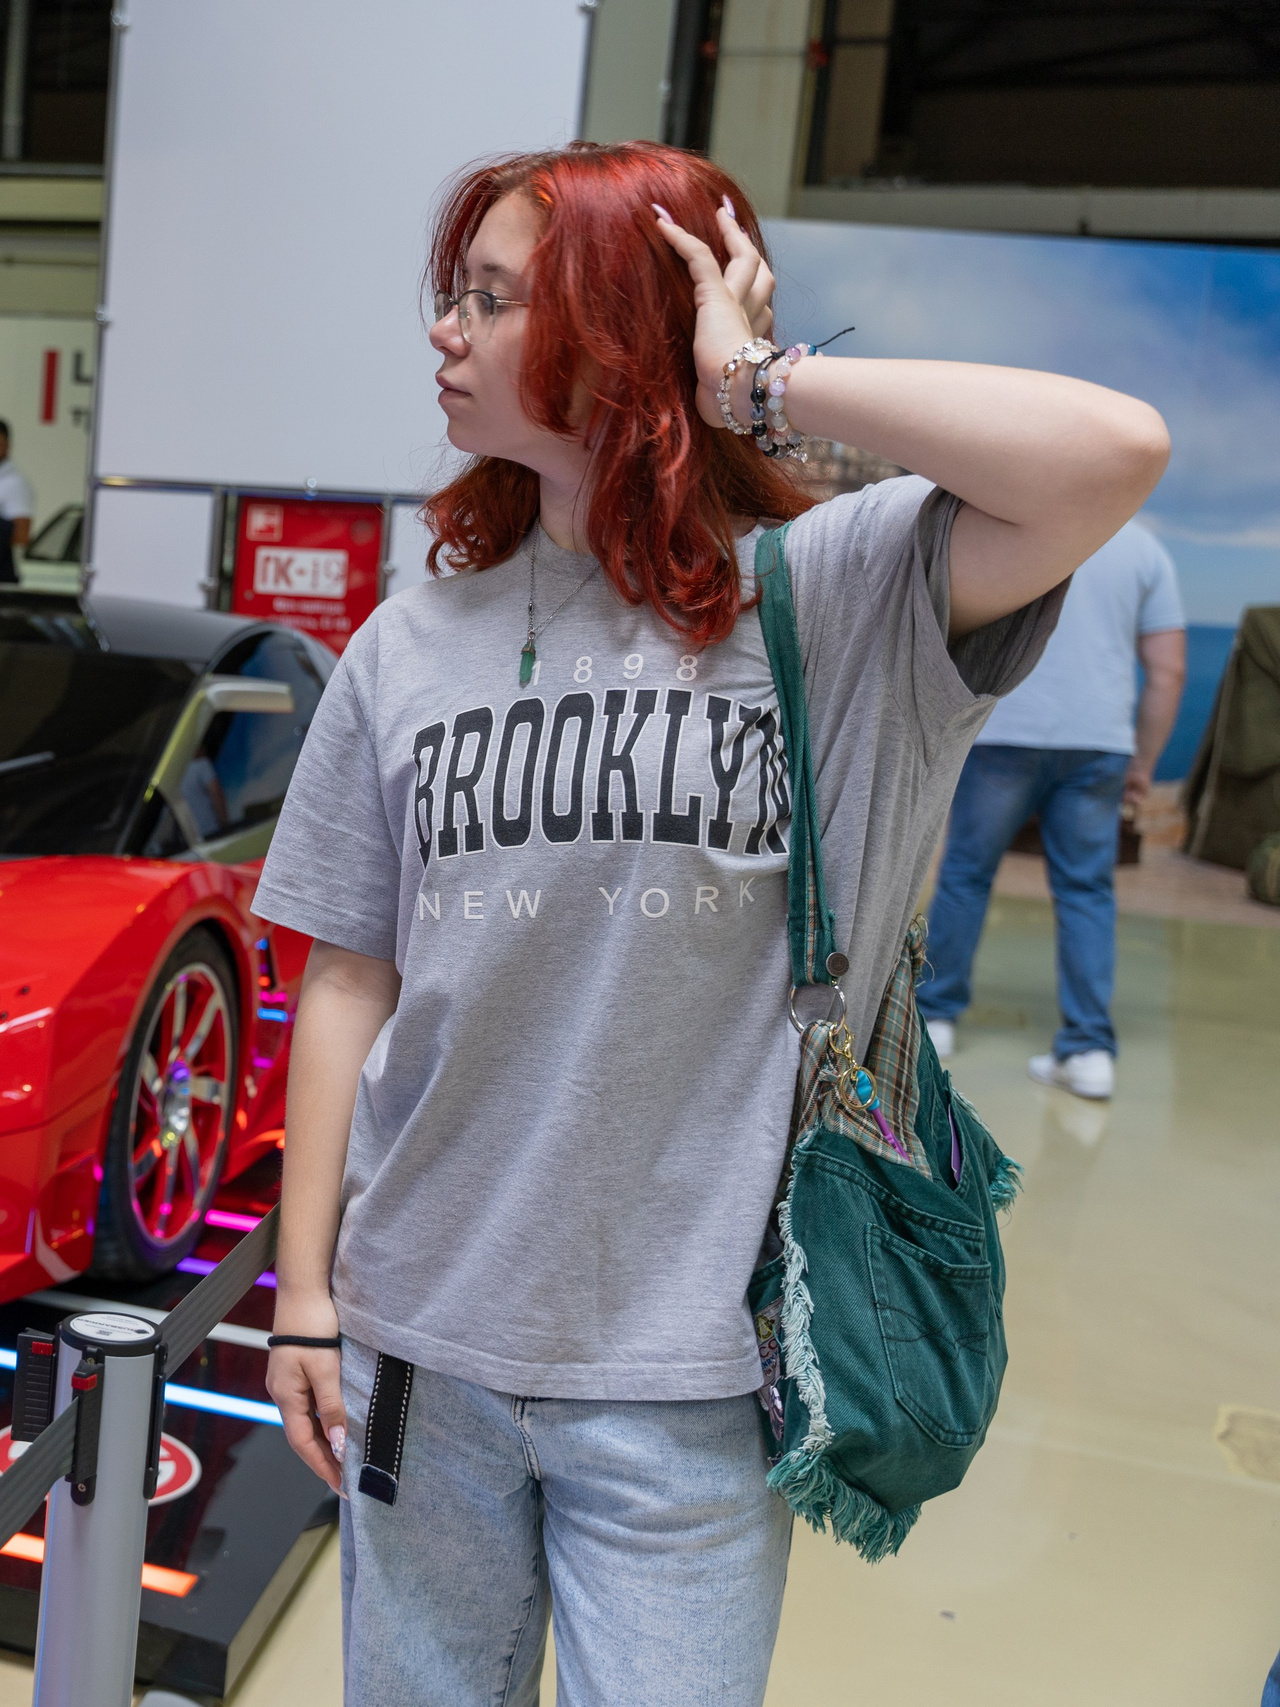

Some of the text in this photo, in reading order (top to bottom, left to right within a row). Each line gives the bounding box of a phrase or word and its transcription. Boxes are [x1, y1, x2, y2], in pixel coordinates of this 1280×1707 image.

[530, 653, 699, 686] 1898
[411, 687, 792, 870] BROOKLYN
[418, 876, 756, 921] NEW YORK
